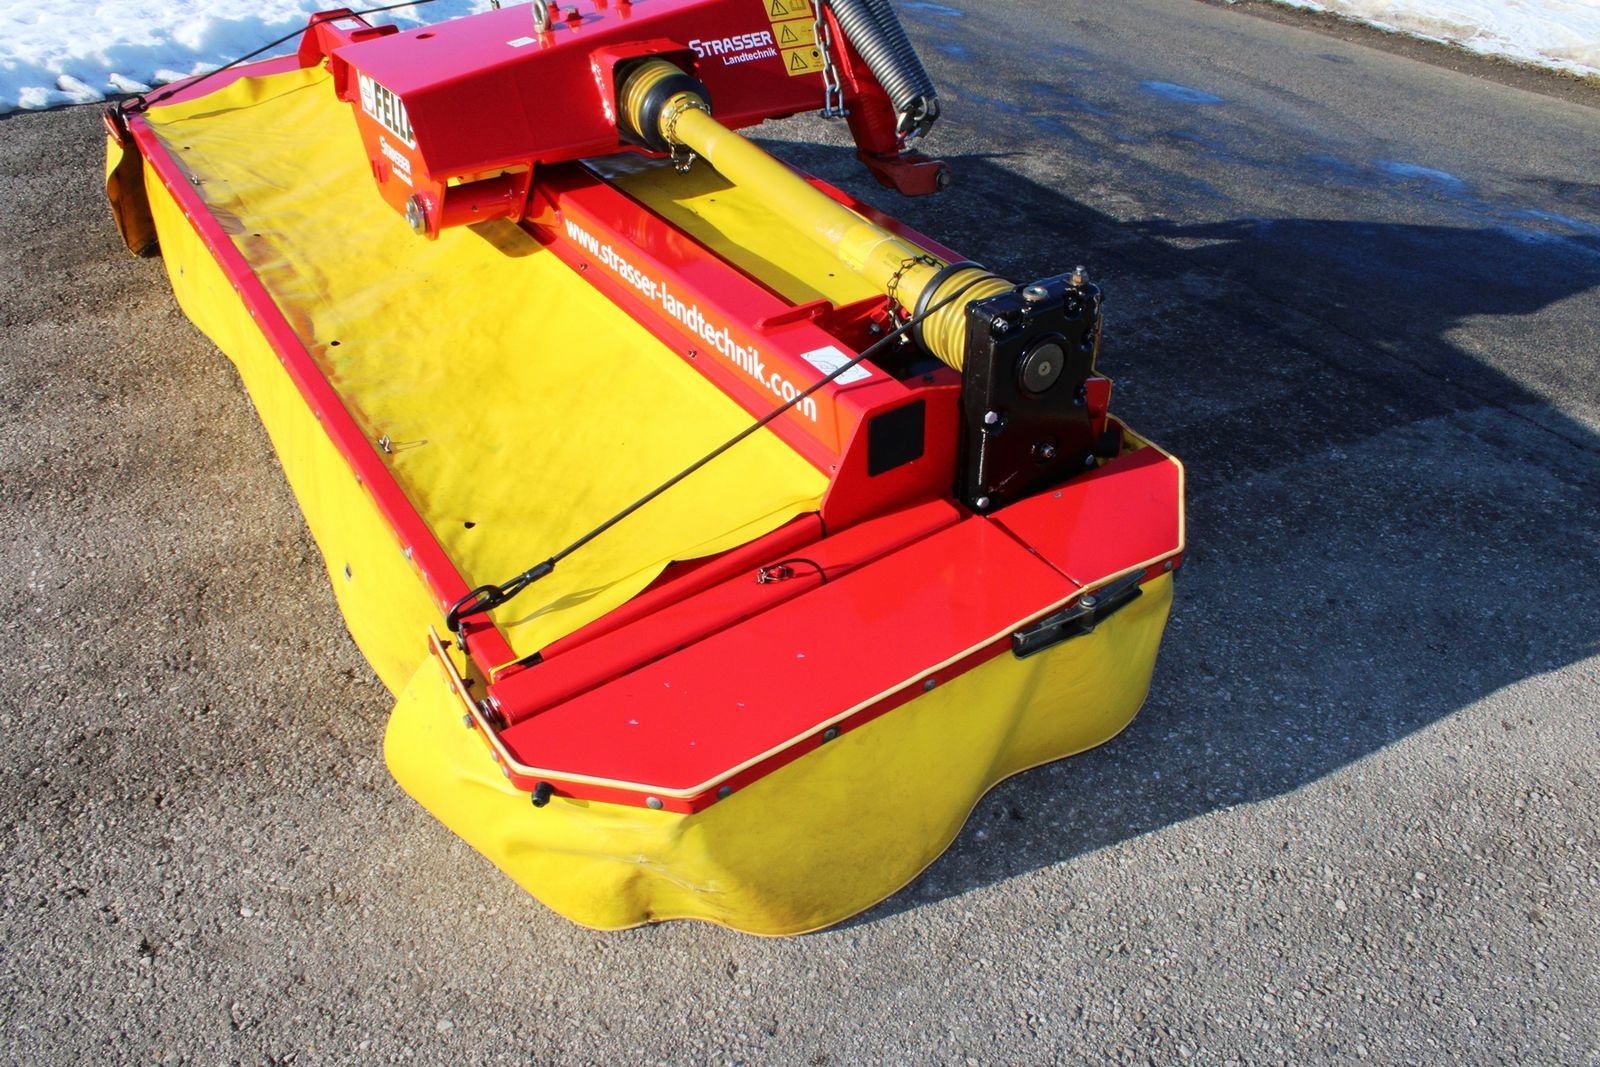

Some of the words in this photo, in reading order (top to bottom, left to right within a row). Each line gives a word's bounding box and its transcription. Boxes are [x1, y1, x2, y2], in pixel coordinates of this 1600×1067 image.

[688, 30, 774, 58] STRASSER
[722, 47, 778, 66] Landtechnik
[564, 218, 817, 422] www.strasser-landtechnik.com
